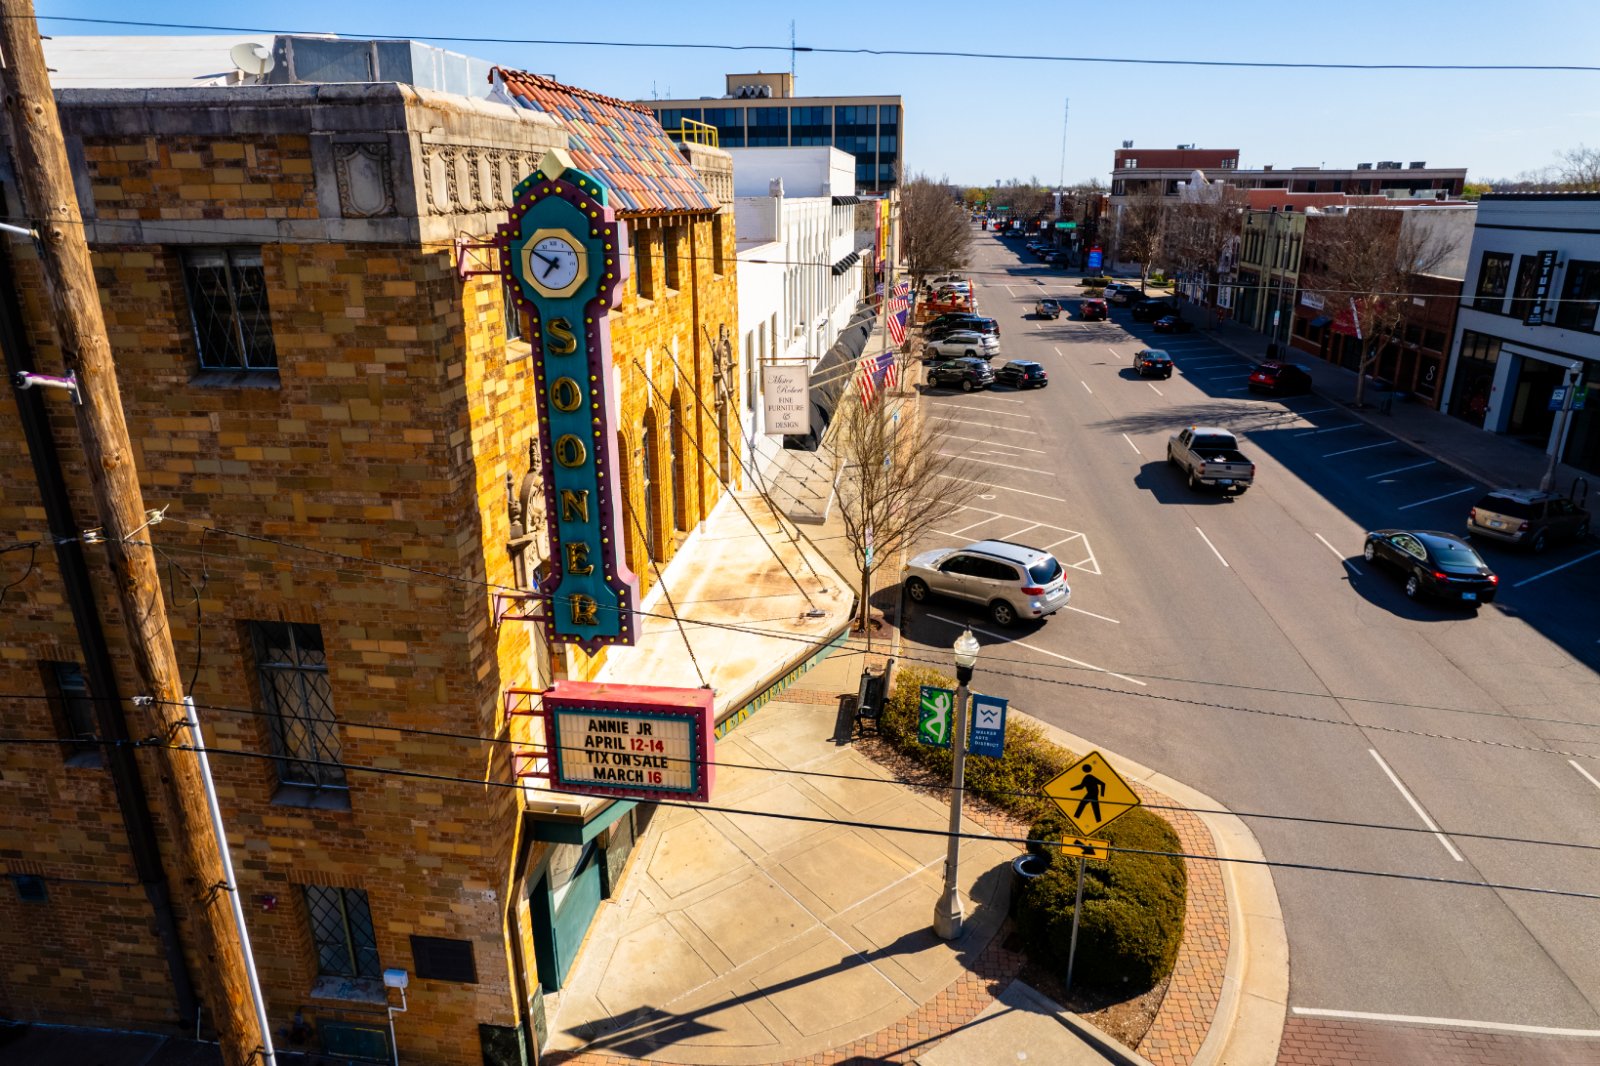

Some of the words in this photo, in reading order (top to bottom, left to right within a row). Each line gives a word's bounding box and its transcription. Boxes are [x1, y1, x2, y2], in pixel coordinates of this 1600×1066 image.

[768, 374, 793, 384] Mister
[777, 385, 803, 394] Robert
[768, 404, 804, 412] FURNITURE
[775, 421, 799, 429] DESIGN
[546, 316, 599, 625] SOONER
[588, 719, 629, 735] ANNIE
[636, 723, 652, 736] JR
[584, 735, 626, 751] APRIL
[630, 738, 665, 754] 12-14
[586, 750, 609, 766] TIX
[612, 753, 632, 767] ON
[633, 755, 669, 770] SALE
[593, 766, 644, 784] MARCH
[647, 771, 663, 785] 16
